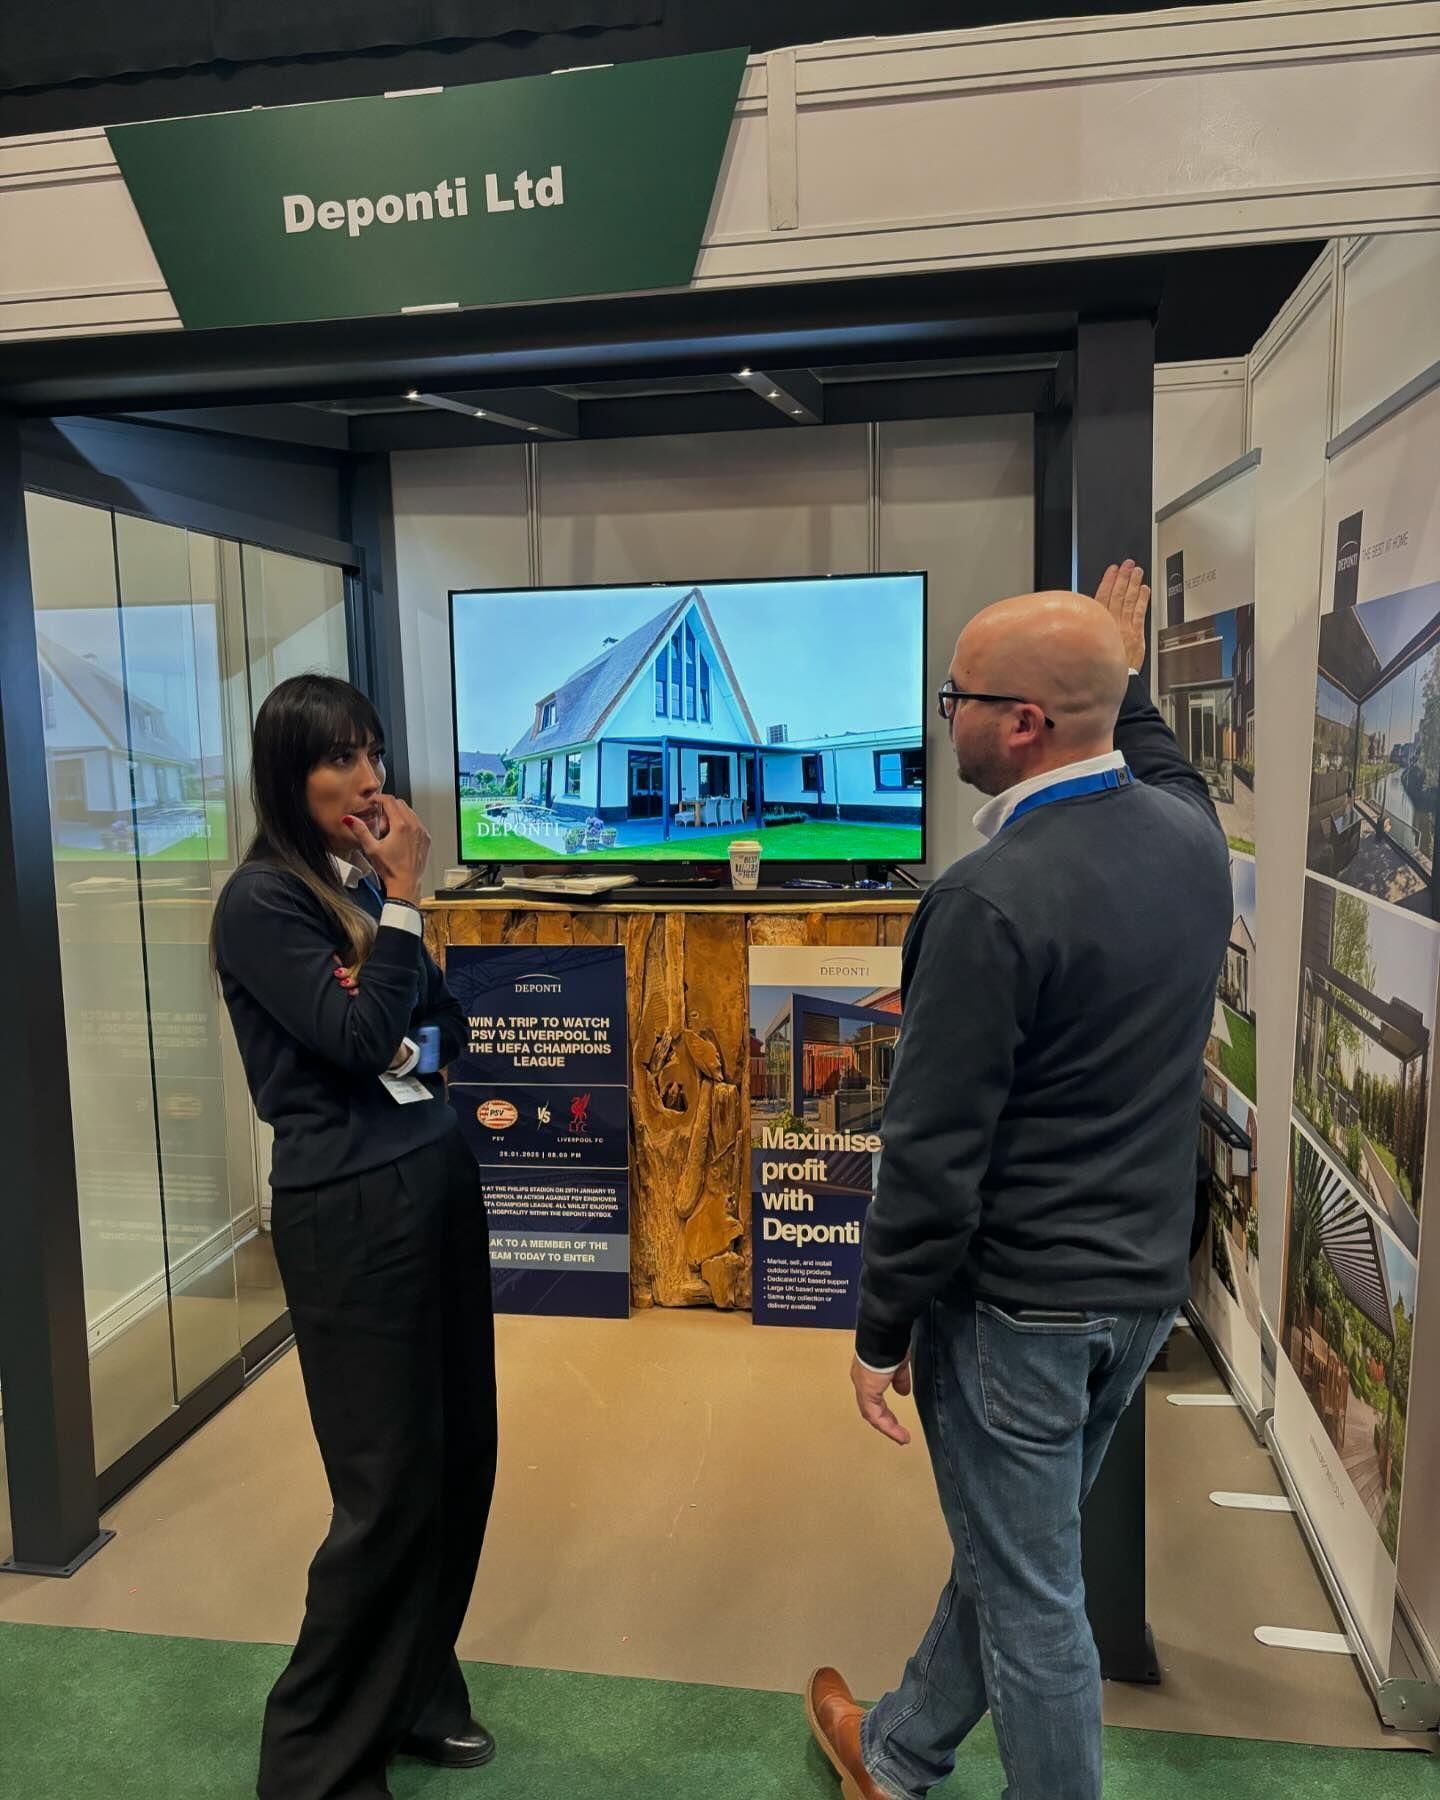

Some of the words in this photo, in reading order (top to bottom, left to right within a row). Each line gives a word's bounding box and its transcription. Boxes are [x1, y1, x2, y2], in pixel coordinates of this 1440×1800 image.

[282, 176, 468, 237] Deponti
[485, 165, 564, 213] Ltd
[1372, 541, 1385, 558] BEST
[476, 822, 560, 837] DEPONTI
[820, 966, 870, 976] DEPONTI
[515, 984, 562, 993] DEPONTI
[468, 1016, 492, 1028] WIN
[496, 1017, 506, 1028] A
[509, 1017, 538, 1028] TRIP
[542, 1017, 559, 1028] TO
[563, 1017, 610, 1028] WATCH
[471, 1030, 496, 1040] PSV
[500, 1030, 515, 1040] VS
[519, 1030, 590, 1042] LIVERPOOL
[594, 1031, 607, 1042] IN
[468, 1042, 493, 1054] THE
[496, 1042, 530, 1054] UEFA
[534, 1043, 612, 1054] CHAMPIONS
[514, 1056, 566, 1068] LEAGUE
[490, 1108, 505, 1117] PSV
[537, 1106, 551, 1124] VS
[568, 1122, 588, 1133] LFC
[762, 1126, 882, 1153] Maximise
[762, 1158, 828, 1186] profit
[762, 1187, 814, 1212] with
[762, 1217, 860, 1248] Deponti
[505, 1238, 519, 1248] TO
[520, 1239, 528, 1248] A
[530, 1240, 572, 1249] MEMBER
[574, 1240, 587, 1250] OF
[589, 1241, 608, 1250] THE
[514, 1252, 546, 1261] TODAY
[548, 1252, 561, 1262] TO
[564, 1253, 596, 1263] ENTER
[790, 1268, 806, 1276] living
